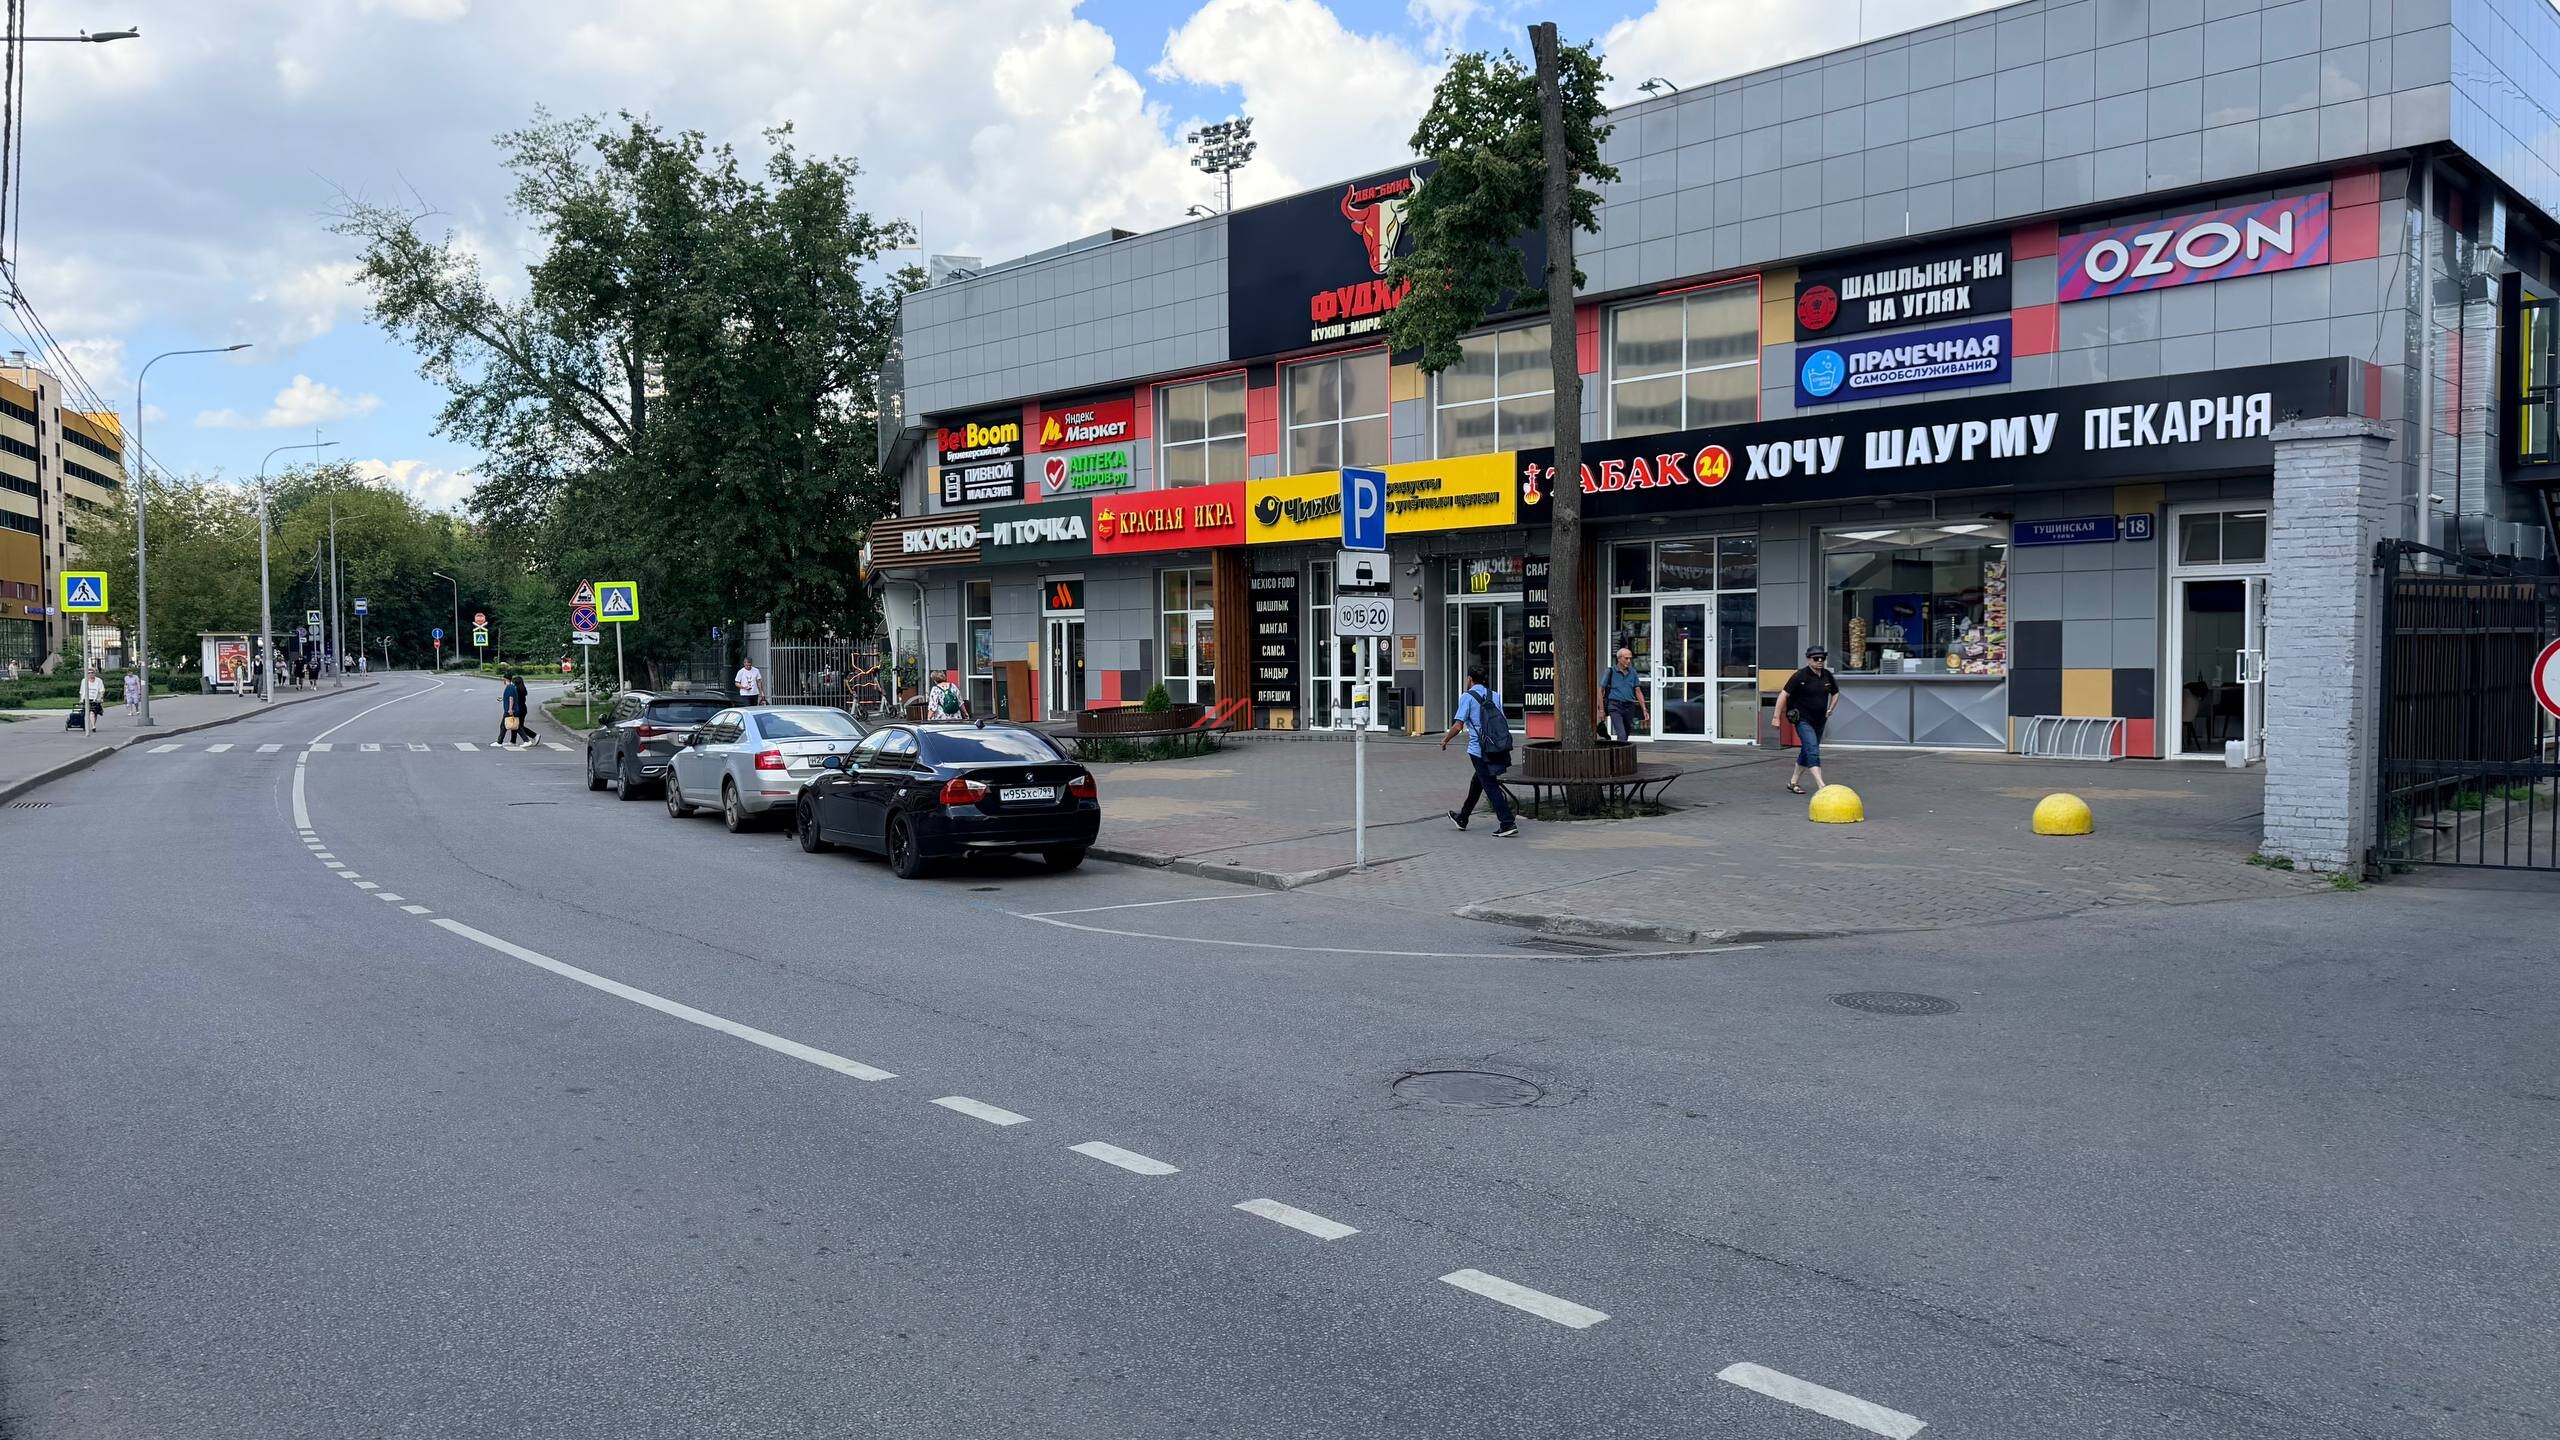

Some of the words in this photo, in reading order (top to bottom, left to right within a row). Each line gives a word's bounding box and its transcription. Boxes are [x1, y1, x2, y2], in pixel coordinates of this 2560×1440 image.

[1356, 188, 1376, 202] ДВА
[1380, 178, 1412, 195] БЫКА
[2085, 211, 2294, 283] OZON
[1841, 251, 2004, 300] ШАШЛЫКИ-КИ
[1868, 298, 1896, 323] НА
[1902, 286, 1971, 318] УГЛЯХ
[1312, 323, 1345, 342] КУХНИ
[1849, 335, 2000, 374] ПРАЧЕЧНАЯ
[1854, 360, 1992, 385] САМООБСЛУЖИВАНИЯ
[1065, 412, 1094, 425] Яндекс
[2084, 392, 2272, 450] ПЕКАРНЯ
[937, 423, 1019, 451] BetBoom
[1065, 421, 1126, 442] Маркет
[1745, 434, 1844, 481] ХОЧУ
[1865, 412, 2059, 470] ШАУРМУ
[1071, 450, 1127, 472] АПТЕКА
[1699, 453, 1725, 478] 24
[965, 462, 1013, 482] ПИВНОЙ
[967, 485, 1012, 500] МАГАЗИН
[1386, 478, 1441, 495] родукты
[1284, 494, 1341, 524] Чижи
[1120, 507, 1183, 534] КРАСНАЯ
[1194, 502, 1234, 527] ИКРА
[2130, 520, 2145, 533] 18
[903, 525, 976, 553] ВКУСНО
[1012, 516, 1087, 543] ТОЧКА
[2033, 522, 2095, 534] ТУШИНСКАЯ
[1526, 563, 1550, 576] CRAF
[1251, 578, 1276, 589] MEXICO
[1278, 577, 1295, 588] FOOD
[1529, 590, 1547, 602] ПИЦ
[1256, 600, 1289, 612] ШАШЛЫК
[1343, 611, 1351, 621] 10
[1355, 610, 1365, 623] 15
[1370, 609, 1386, 624] 20
[1529, 615, 1550, 628] ВЬЕТ
[1260, 623, 1287, 634] МАНГАЛ
[1262, 645, 1285, 656] САМСА
[1529, 641, 1546, 654] СУП
[1260, 668, 1289, 679] ТАНДЫР
[1533, 667, 1554, 680] БУРР
[1258, 691, 1290, 702] ЛЕПЕШКИ
[1525, 693, 1554, 706] ПИВНО
